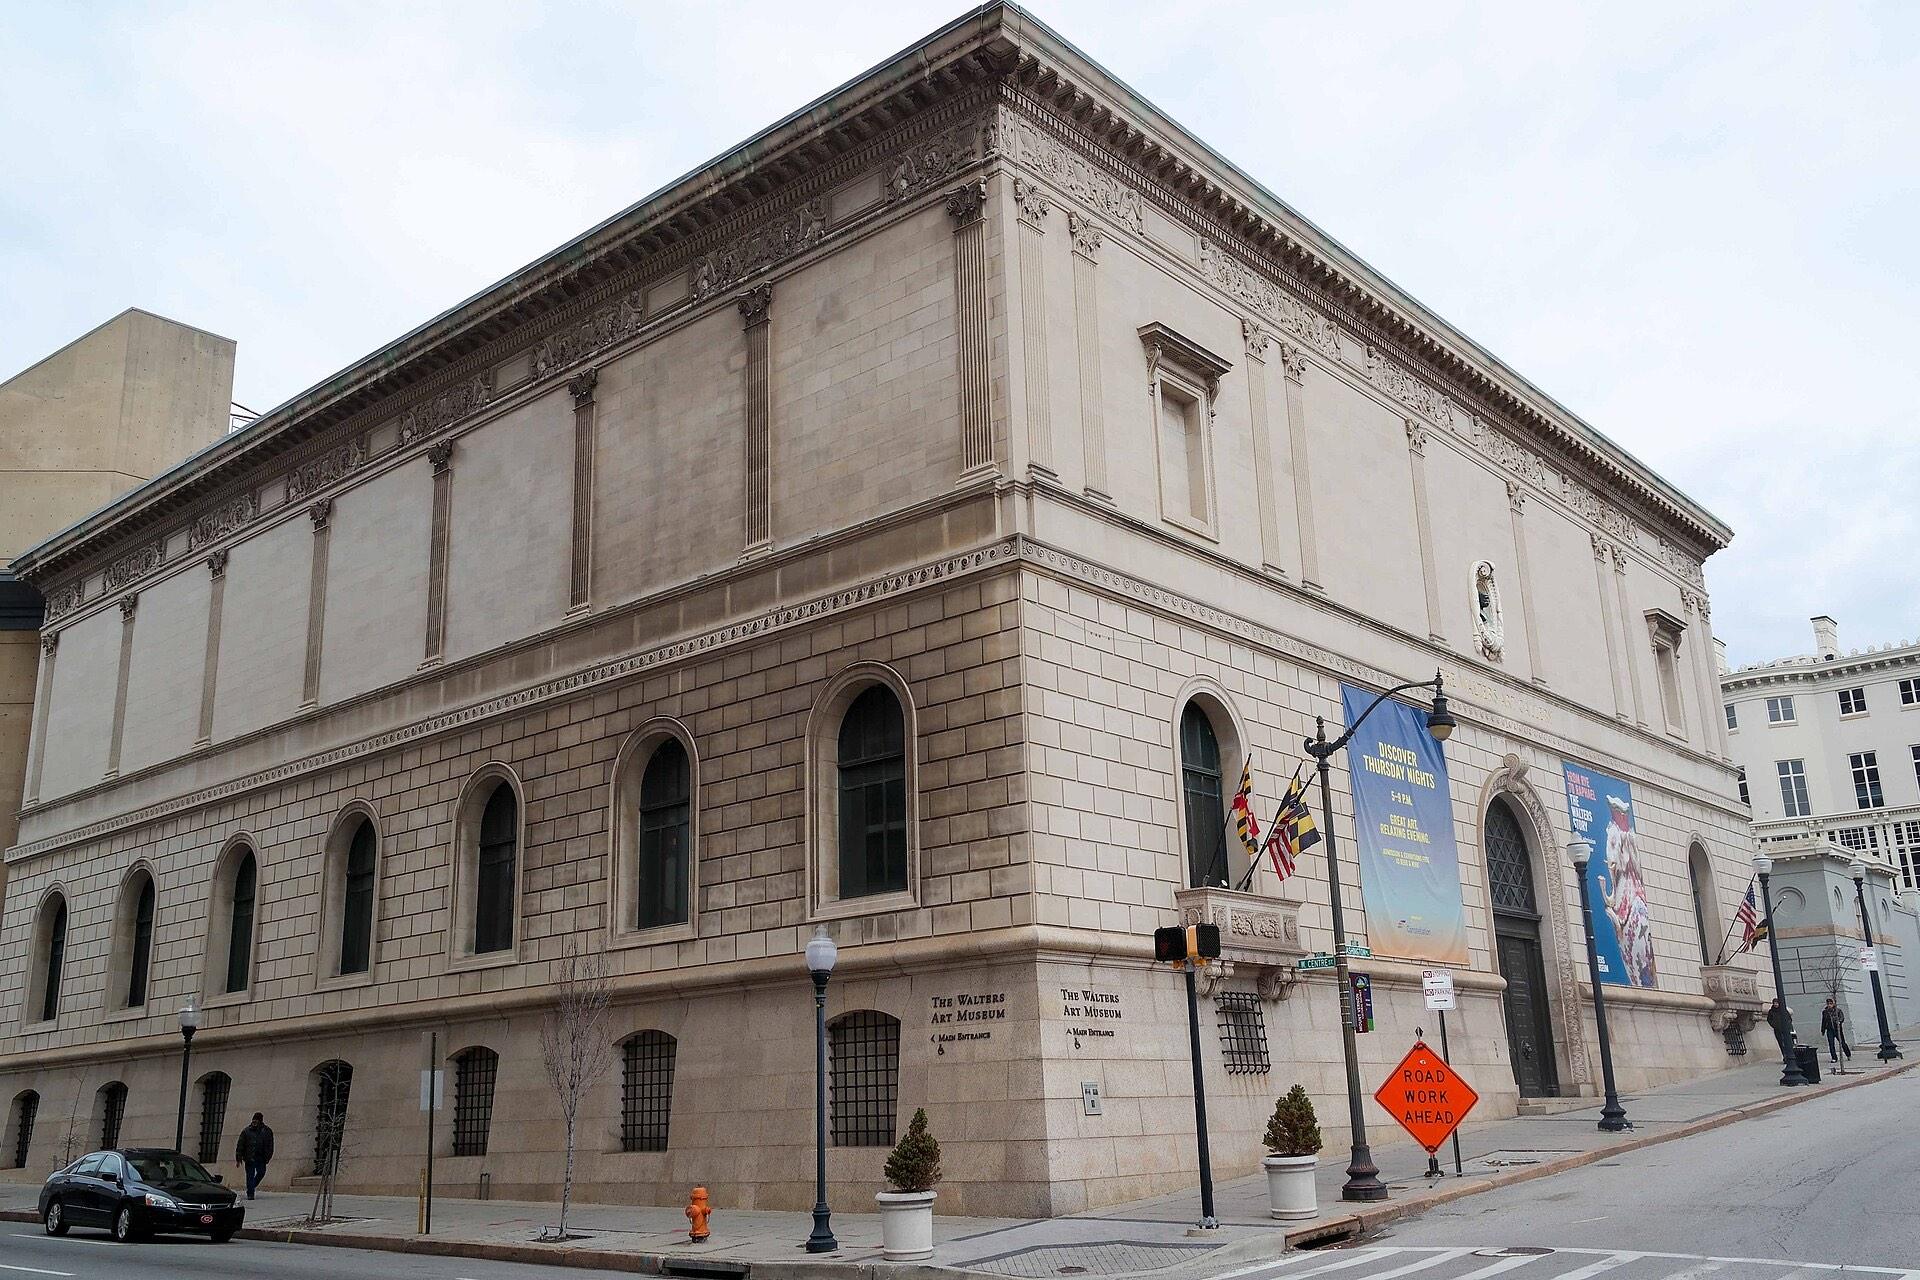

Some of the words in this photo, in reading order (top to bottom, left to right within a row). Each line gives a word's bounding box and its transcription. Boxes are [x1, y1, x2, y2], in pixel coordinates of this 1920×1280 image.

[1378, 741, 1418, 768] DISCOVER
[1363, 754, 1405, 781] THURSDAY
[1407, 767, 1435, 789] NIGHTS
[1569, 793, 1579, 807] THE
[1390, 813, 1406, 827] GREAT
[1571, 805, 1593, 822] WALTERS
[1380, 823, 1406, 839] RELAXING
[1573, 817, 1588, 832] STORY
[1307, 958, 1328, 968] CENTRE
[957, 993, 1005, 1006] WALTERS
[1081, 990, 1120, 1004] WALTERS
[931, 1011, 953, 1024] ART
[956, 1009, 1006, 1022] MUSEUM
[1063, 1004, 1080, 1017] ART
[1083, 1005, 1122, 1019] MUSEUM
[1403, 1069, 1445, 1083] ROAD
[1404, 1090, 1449, 1104] WORK
[1404, 1110, 1454, 1124] AHEAD
